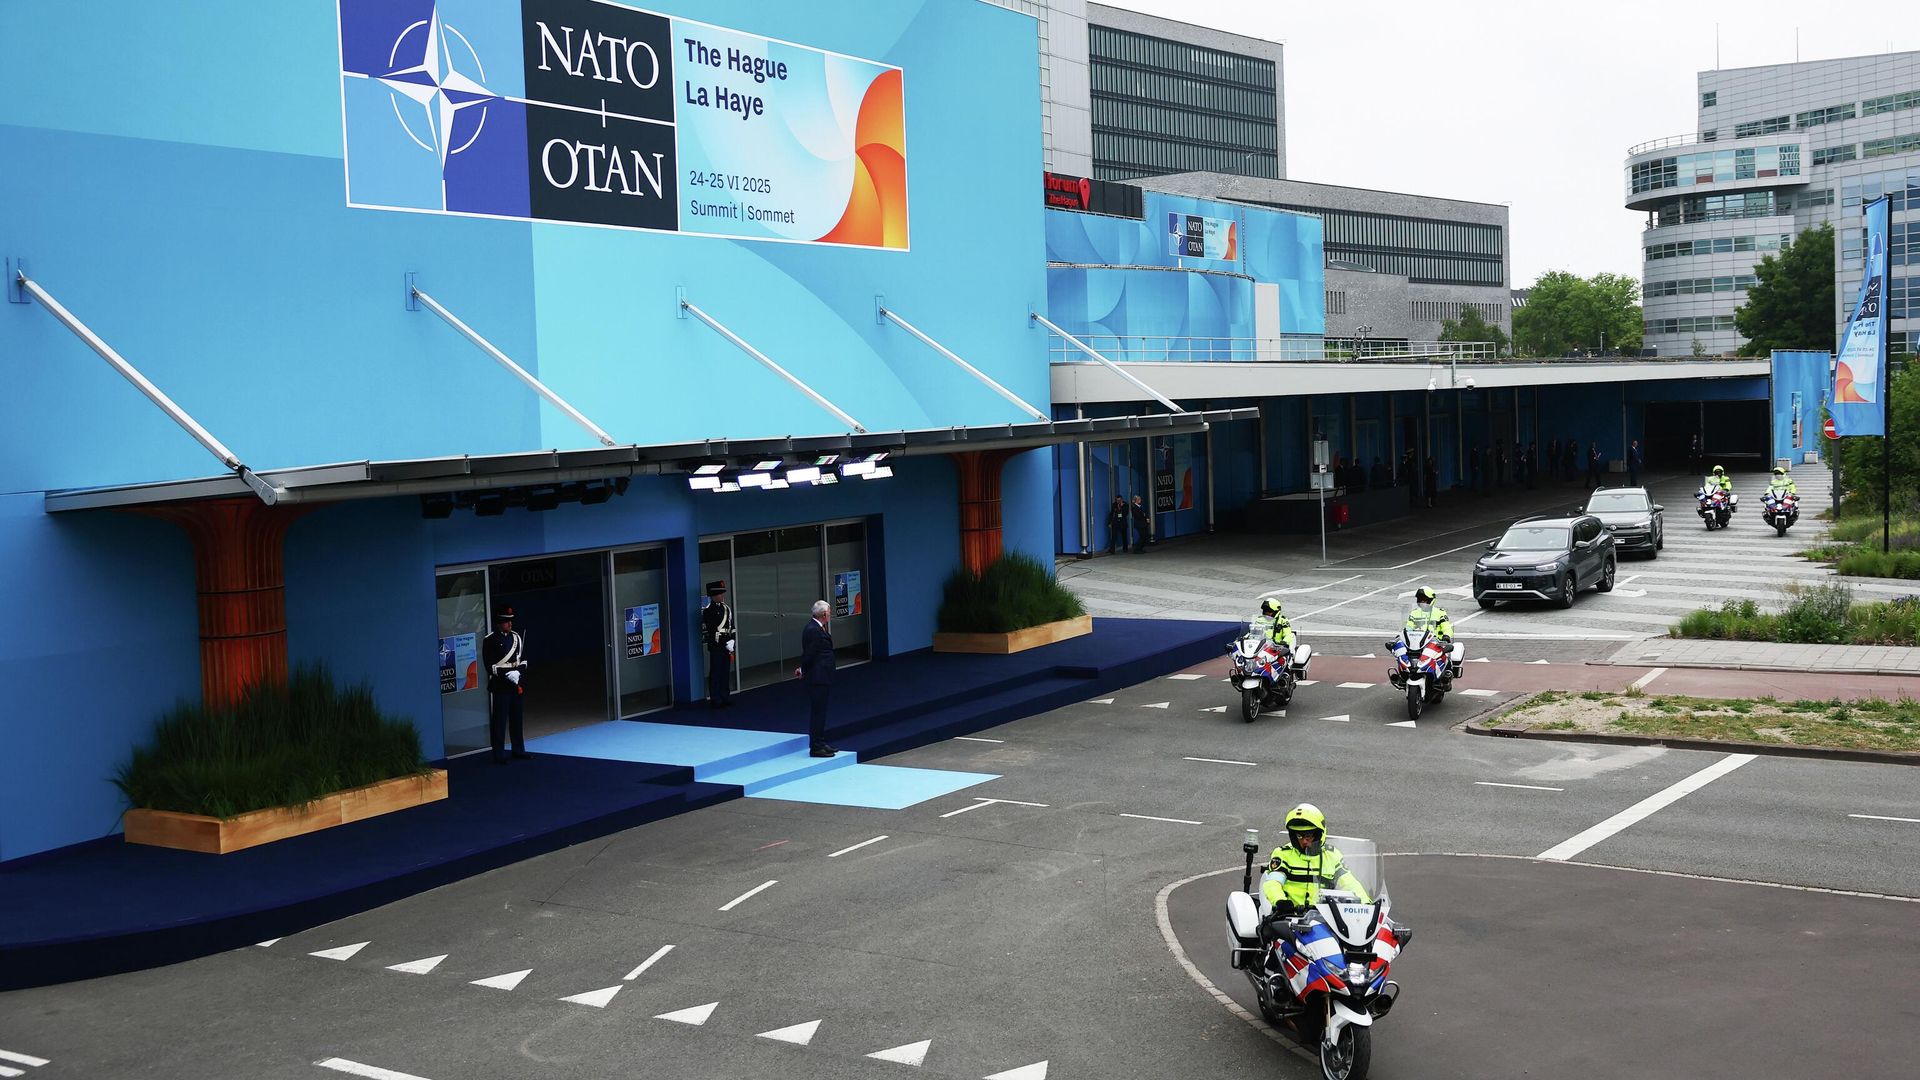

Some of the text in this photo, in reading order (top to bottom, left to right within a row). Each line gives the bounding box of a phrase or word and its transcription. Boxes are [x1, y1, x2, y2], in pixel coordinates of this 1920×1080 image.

[536, 21, 660, 90] NATO
[684, 38, 787, 84] The Hague
[685, 80, 763, 121] La Haye
[542, 138, 665, 200] OTAN
[689, 170, 771, 194] 24-25 VI 2025
[690, 199, 737, 219] Summit
[747, 205, 795, 224] Sommet
[1187, 220, 1203, 232] NATO
[1187, 241, 1203, 252] OTAN
[1157, 475, 1174, 486] NATO
[1157, 495, 1174, 507] OTAN
[627, 634, 643, 643] NATO
[628, 646, 643, 655] OTAN
